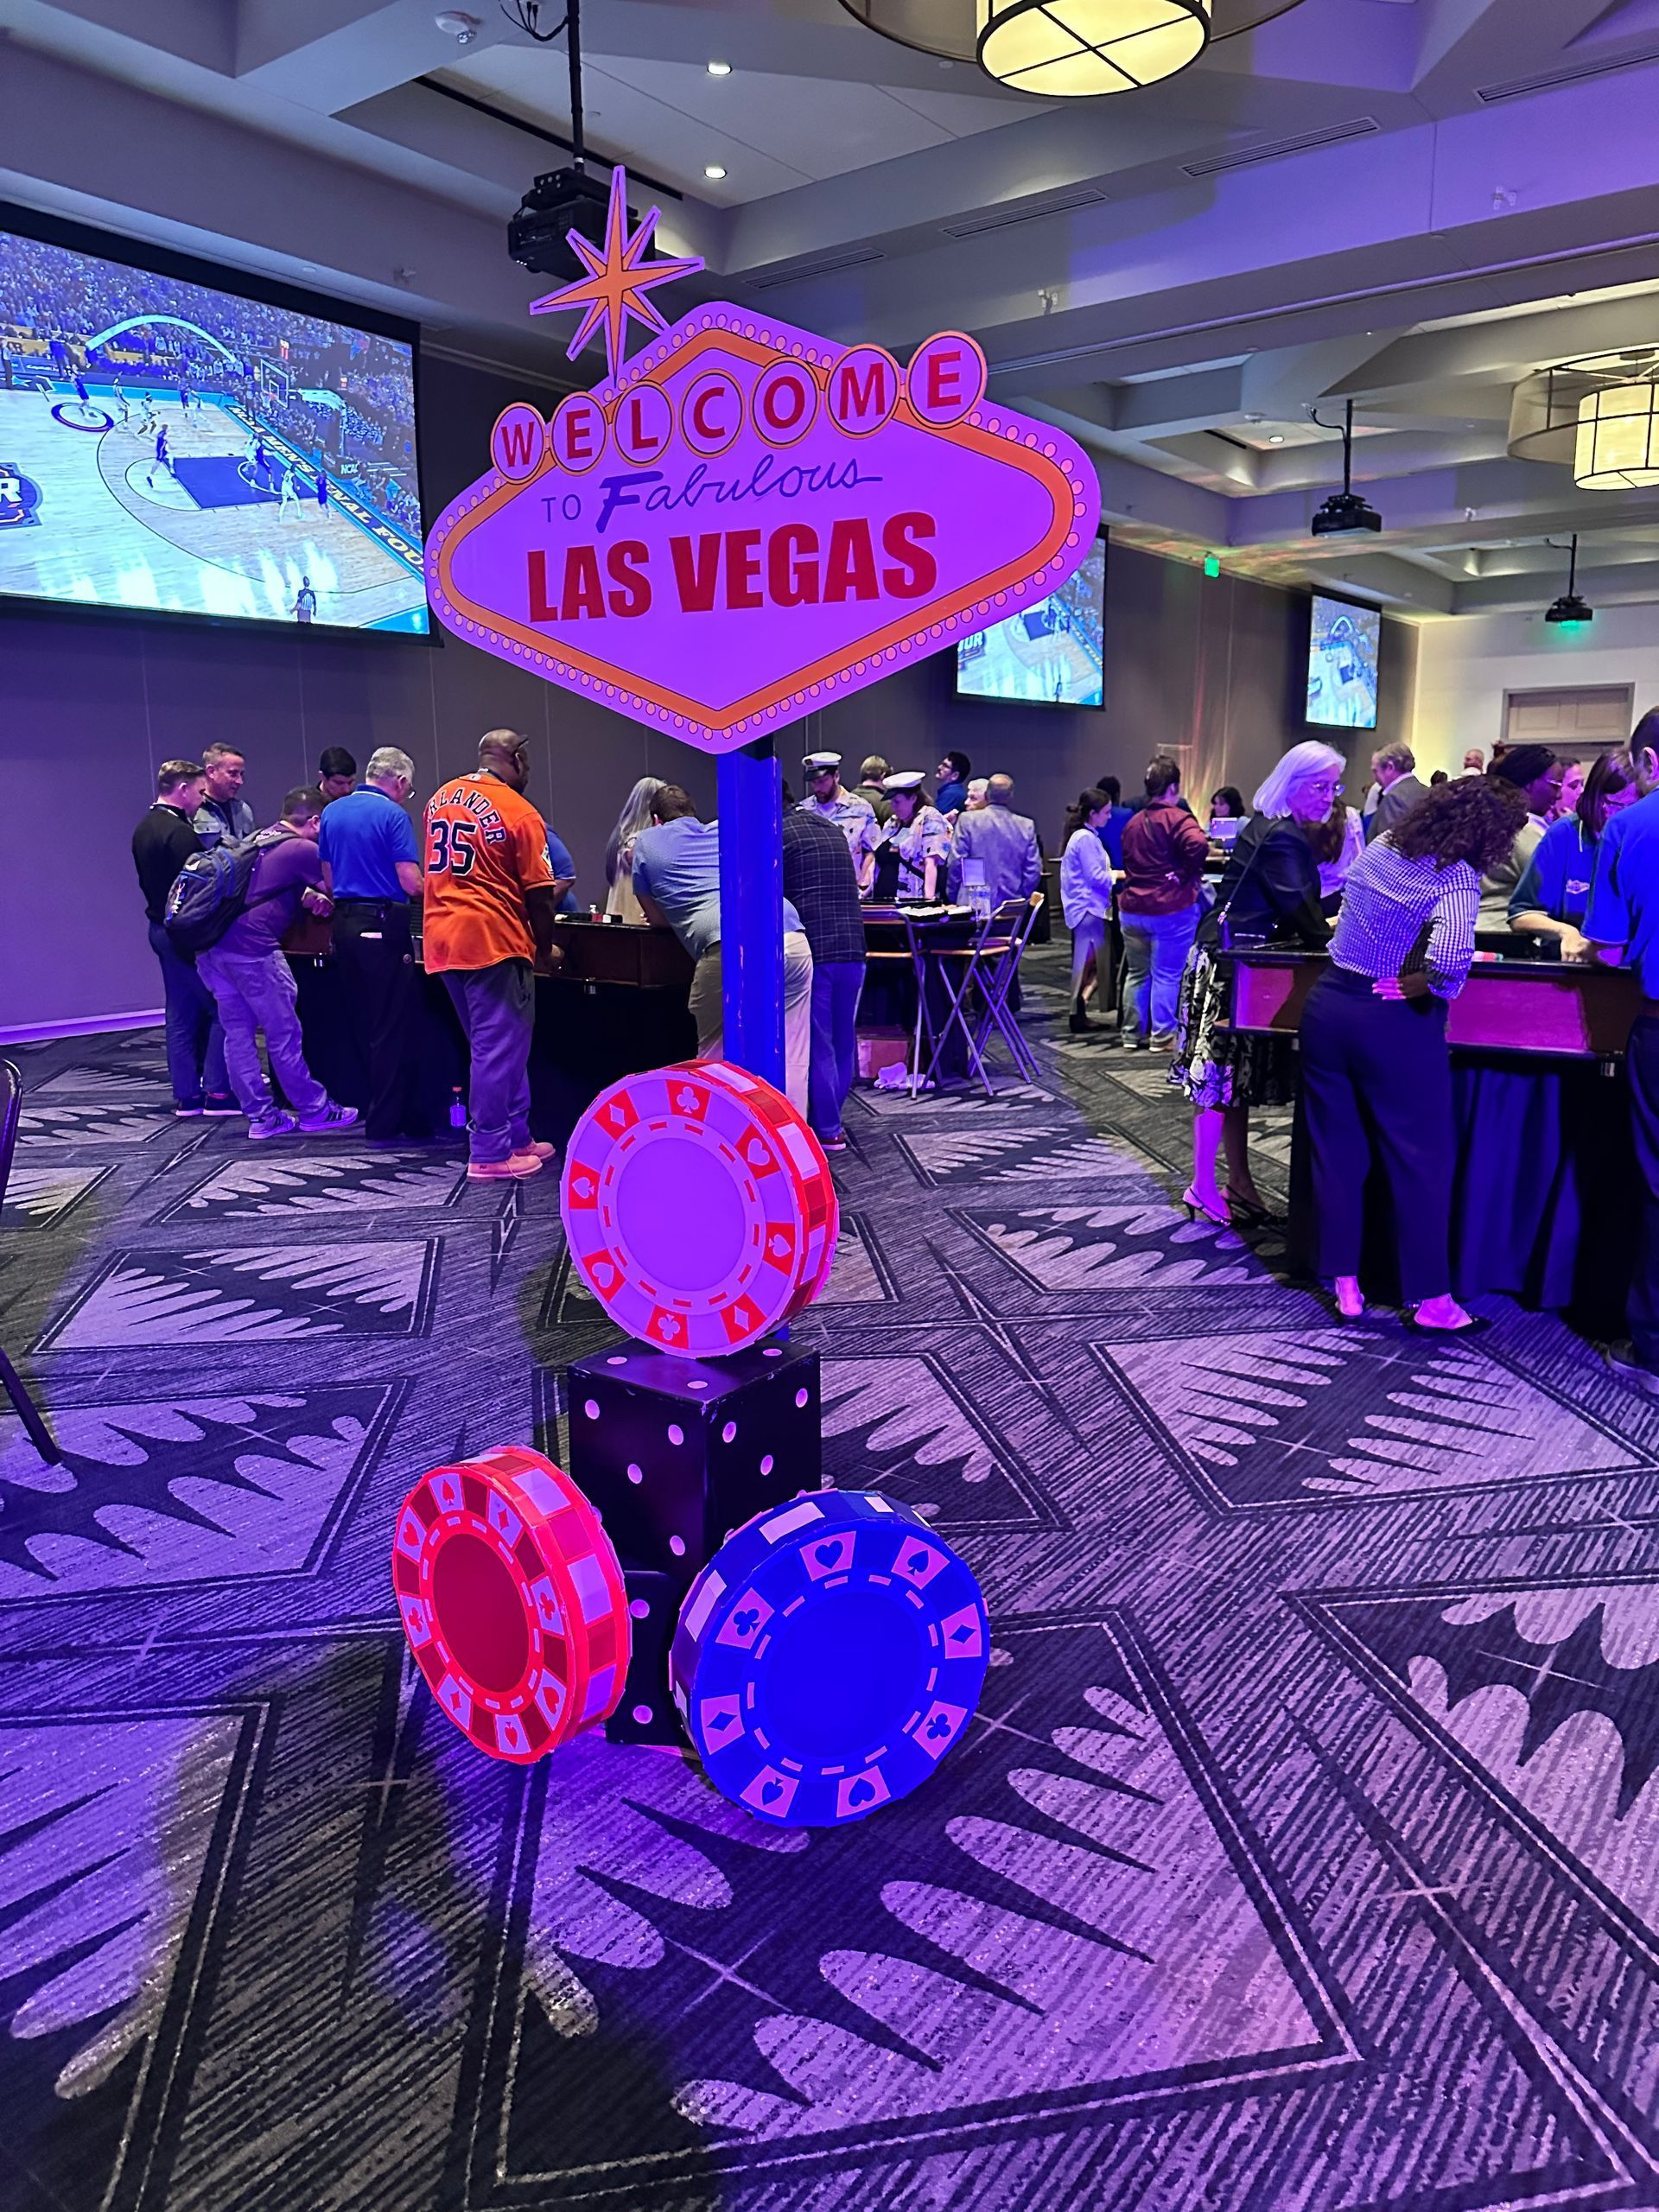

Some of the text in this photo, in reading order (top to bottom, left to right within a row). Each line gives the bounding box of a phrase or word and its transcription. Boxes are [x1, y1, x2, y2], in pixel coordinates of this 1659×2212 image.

[501, 351, 962, 467] WELCOME
[542, 454, 883, 533] TO Fabulous
[372, 526, 424, 571] FOU
[527, 512, 938, 622] LAS VEGAS
[428, 787, 506, 843] RLANDER
[429, 818, 478, 876] 35
